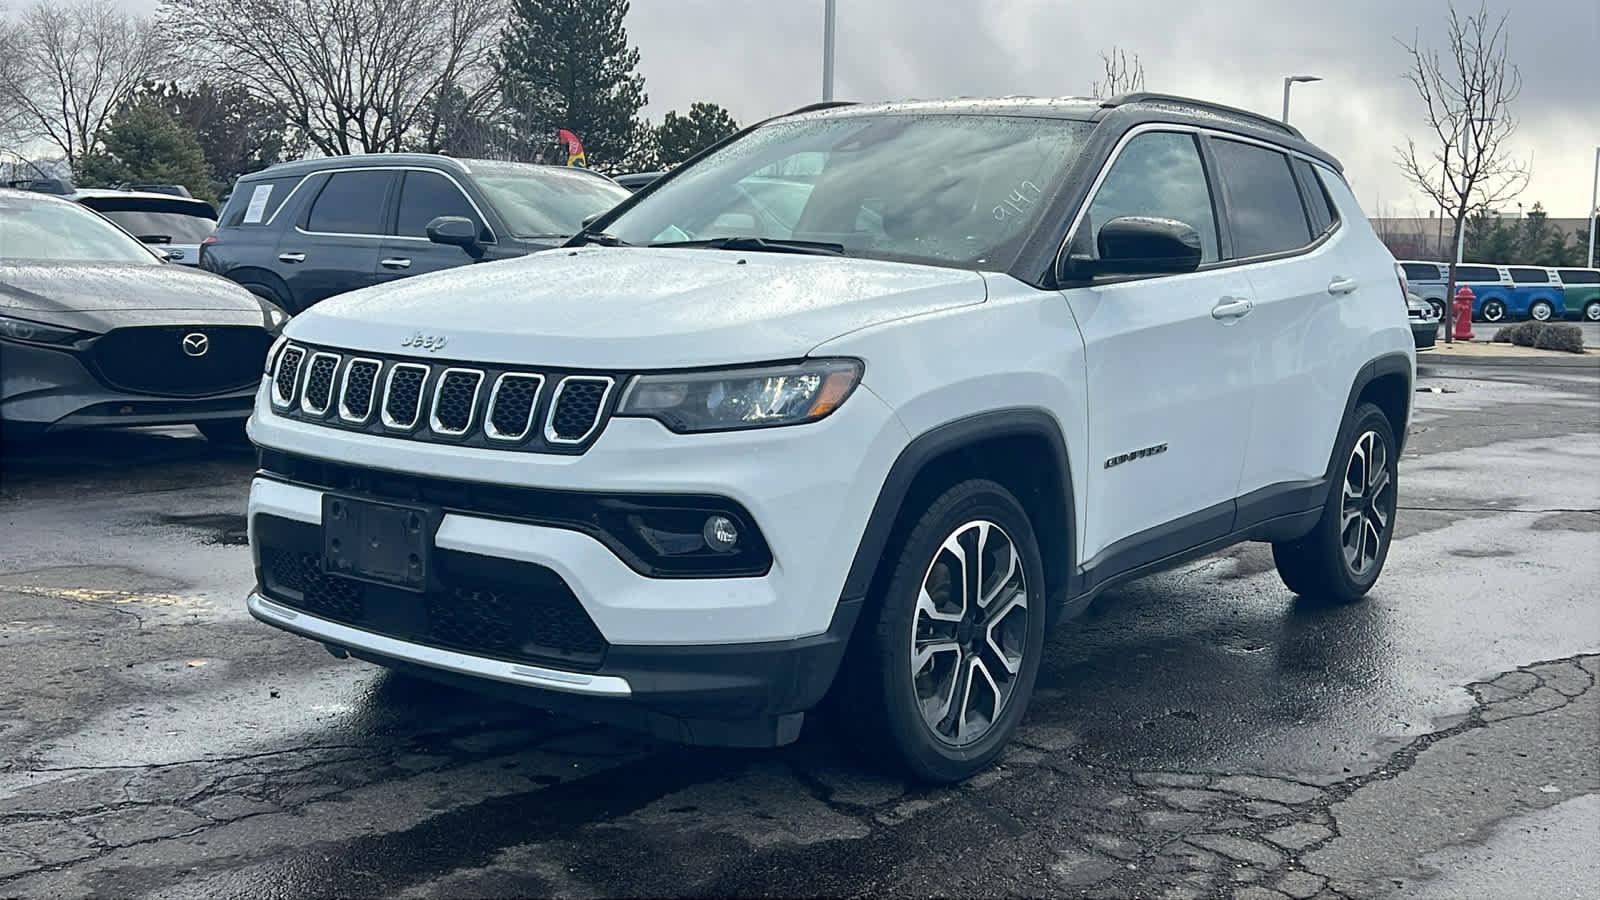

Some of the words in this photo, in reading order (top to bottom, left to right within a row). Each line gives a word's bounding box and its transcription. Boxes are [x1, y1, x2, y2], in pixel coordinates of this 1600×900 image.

[992, 181, 1040, 221] 9147
[401, 332, 448, 353] Jeep
[1103, 442, 1168, 470] COMPASS
